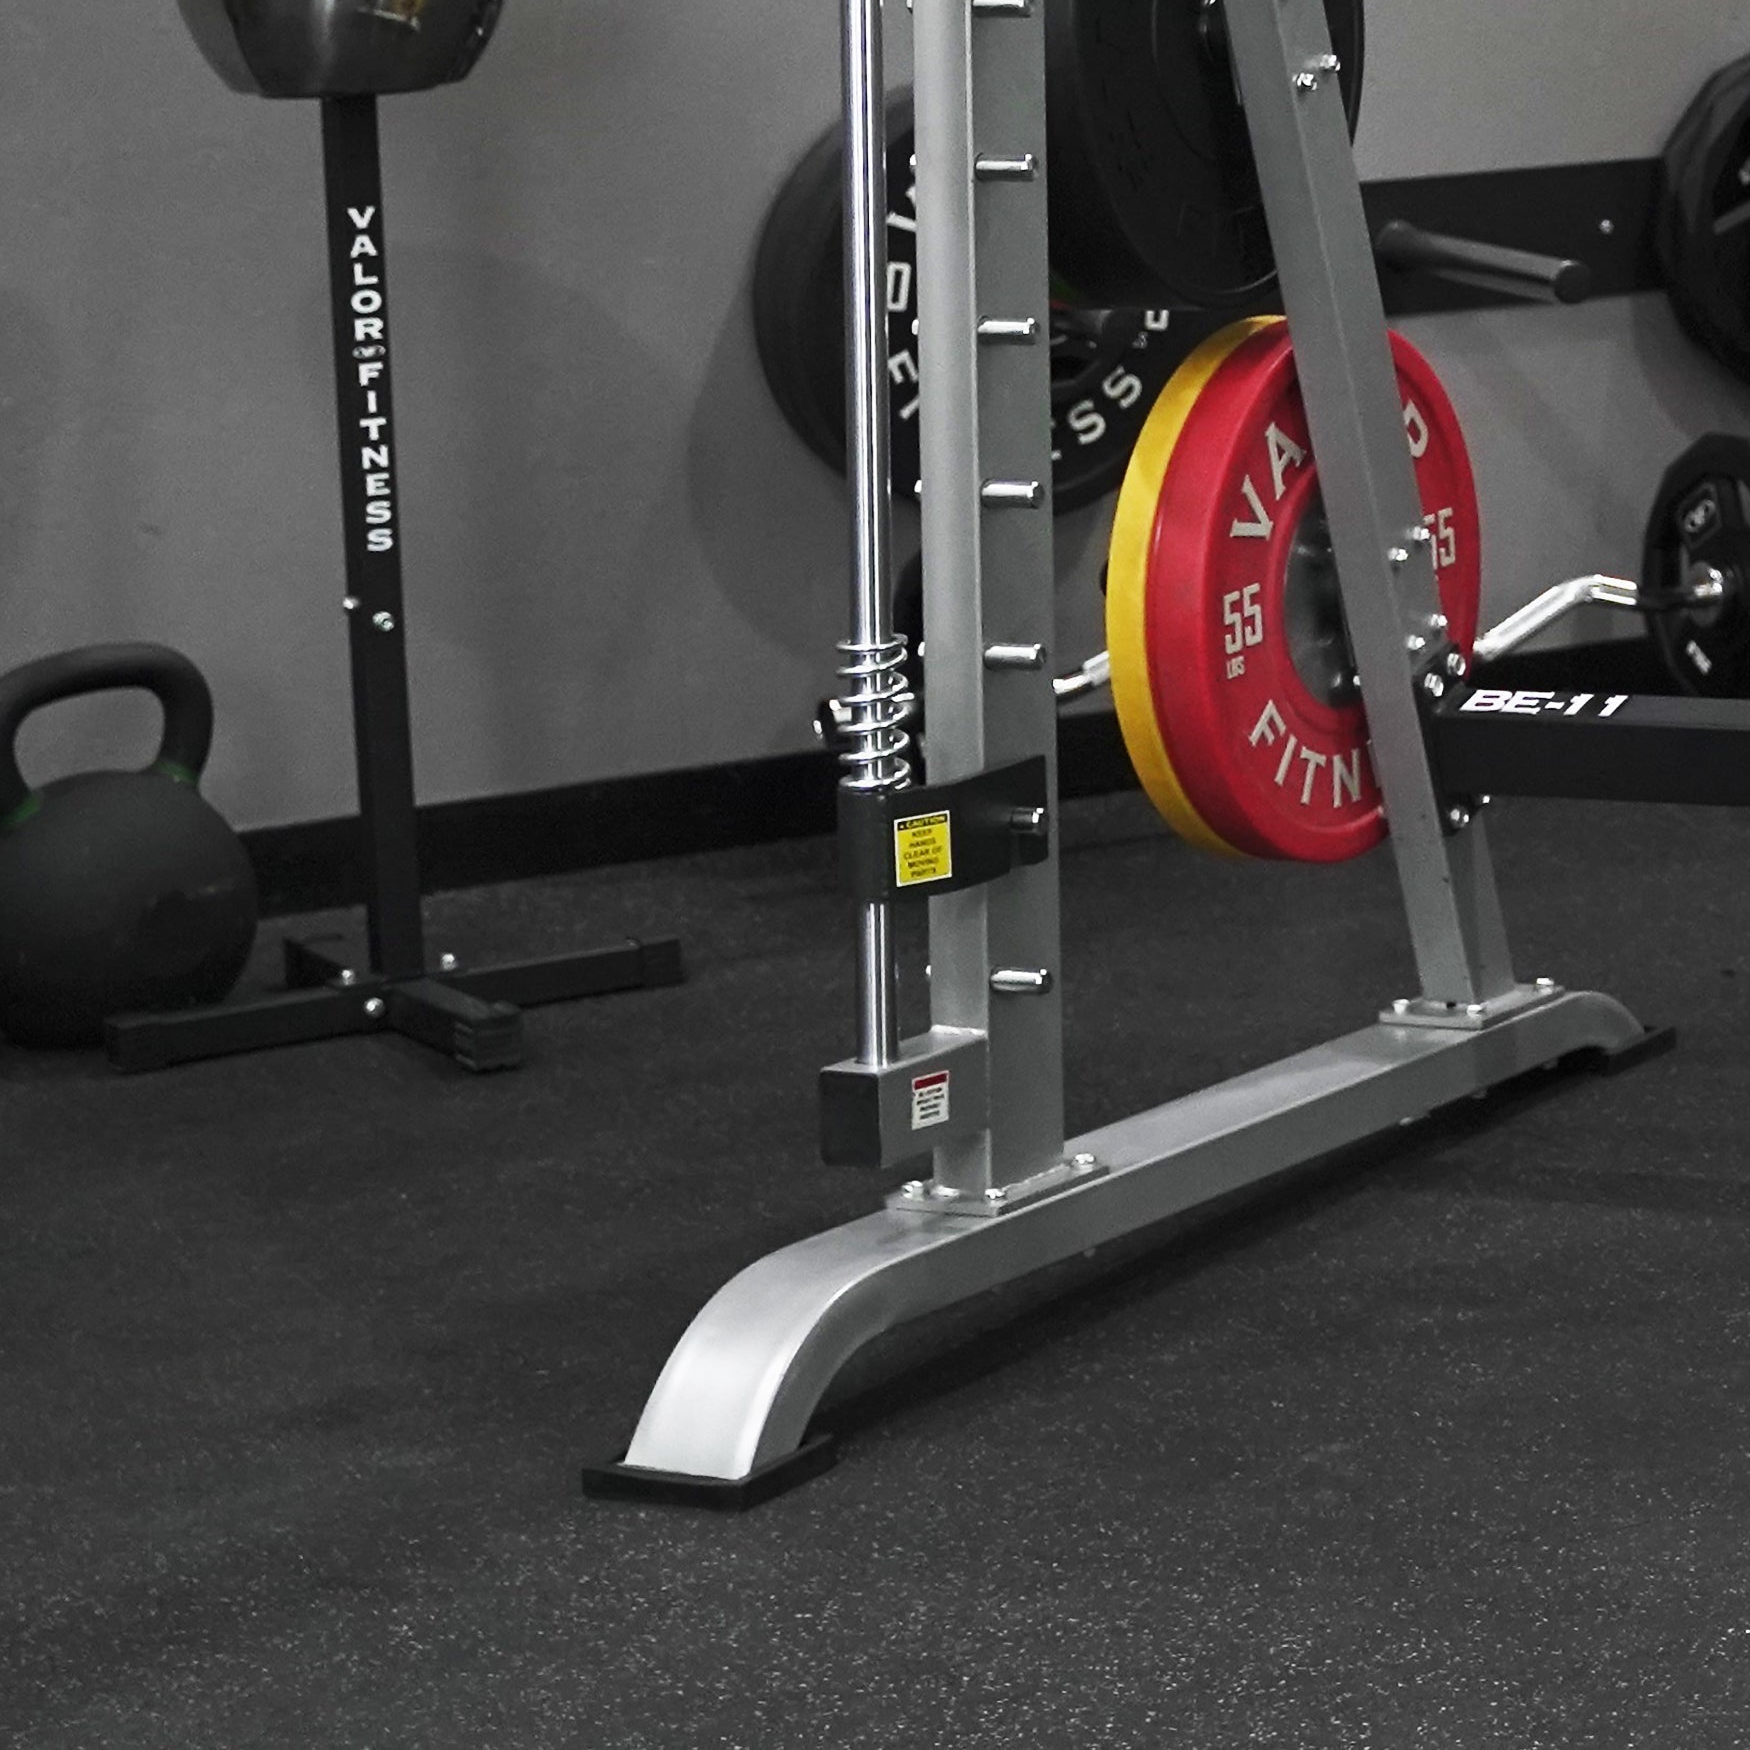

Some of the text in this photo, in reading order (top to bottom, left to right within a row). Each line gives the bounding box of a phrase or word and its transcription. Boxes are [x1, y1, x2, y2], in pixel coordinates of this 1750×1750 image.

[347, 205, 384, 342] VALOR
[358, 361, 395, 553] FITNESS
[1223, 582, 1263, 654] 55
[1459, 689, 1629, 718] BE-11
